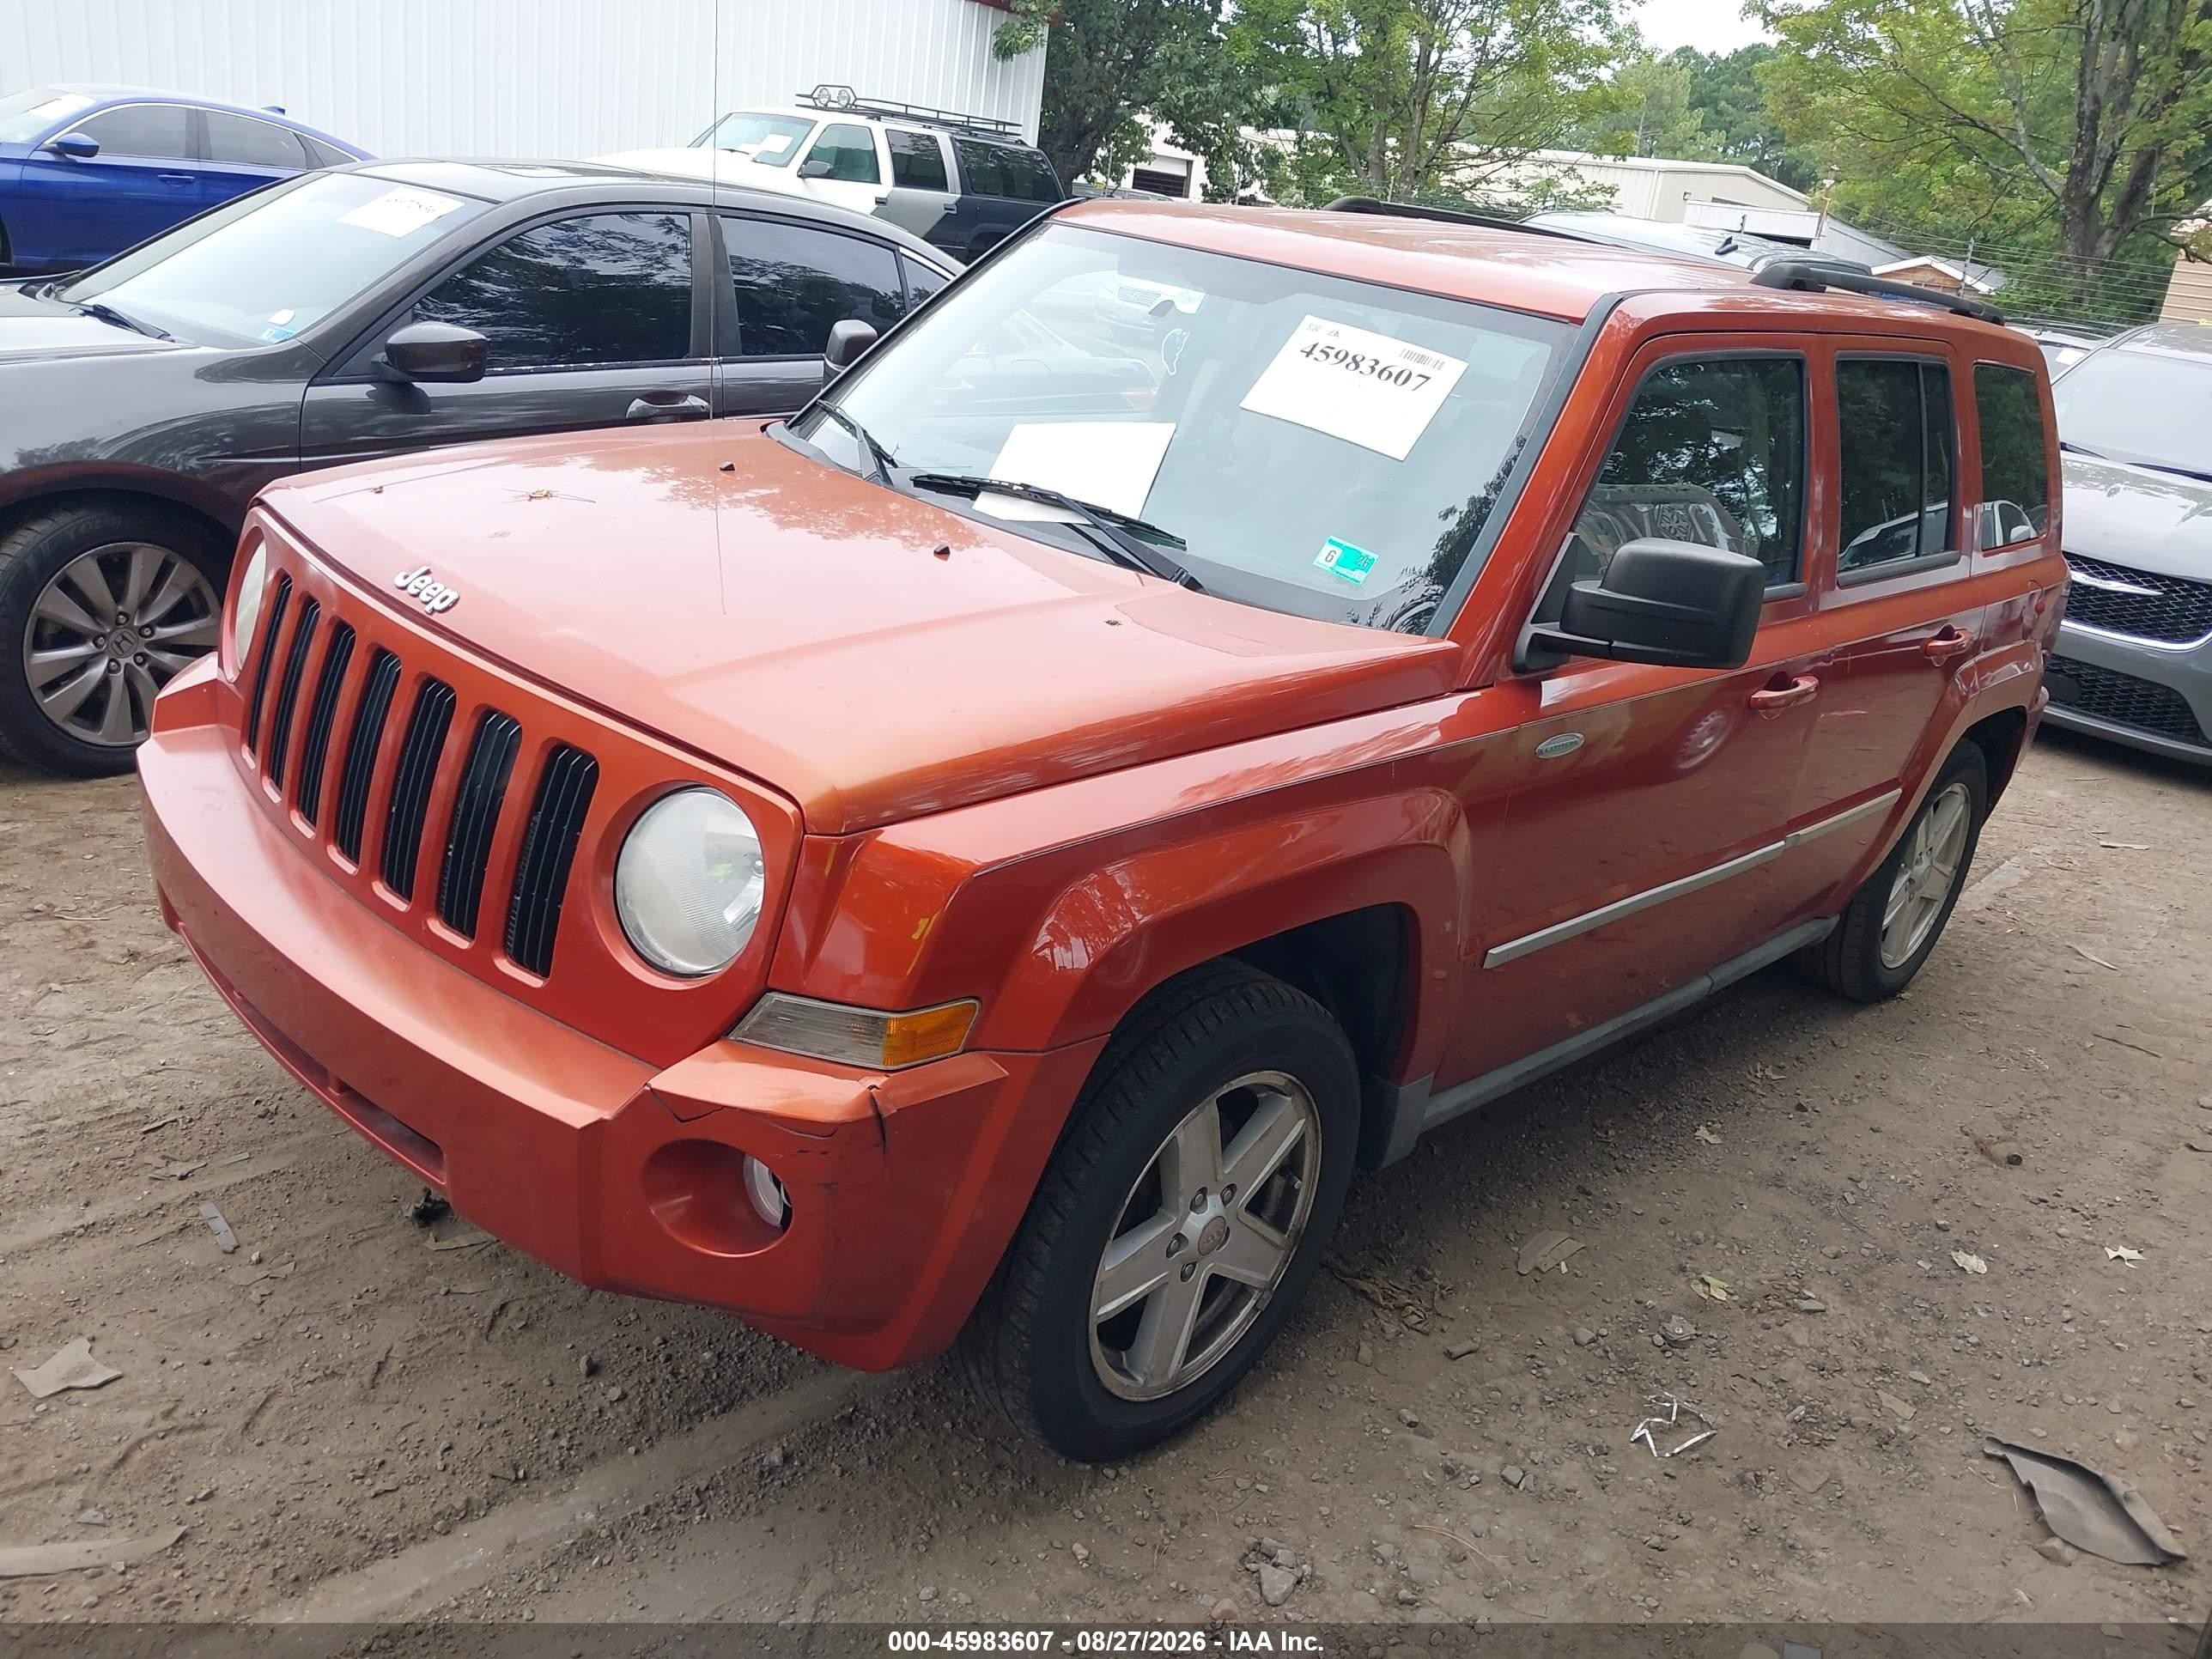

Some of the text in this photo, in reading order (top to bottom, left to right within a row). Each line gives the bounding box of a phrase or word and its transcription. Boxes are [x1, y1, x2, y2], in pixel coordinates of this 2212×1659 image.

[1299, 342, 1432, 392] 45983607
[1324, 549, 1338, 563] 6
[393, 565, 460, 615] Jeep
